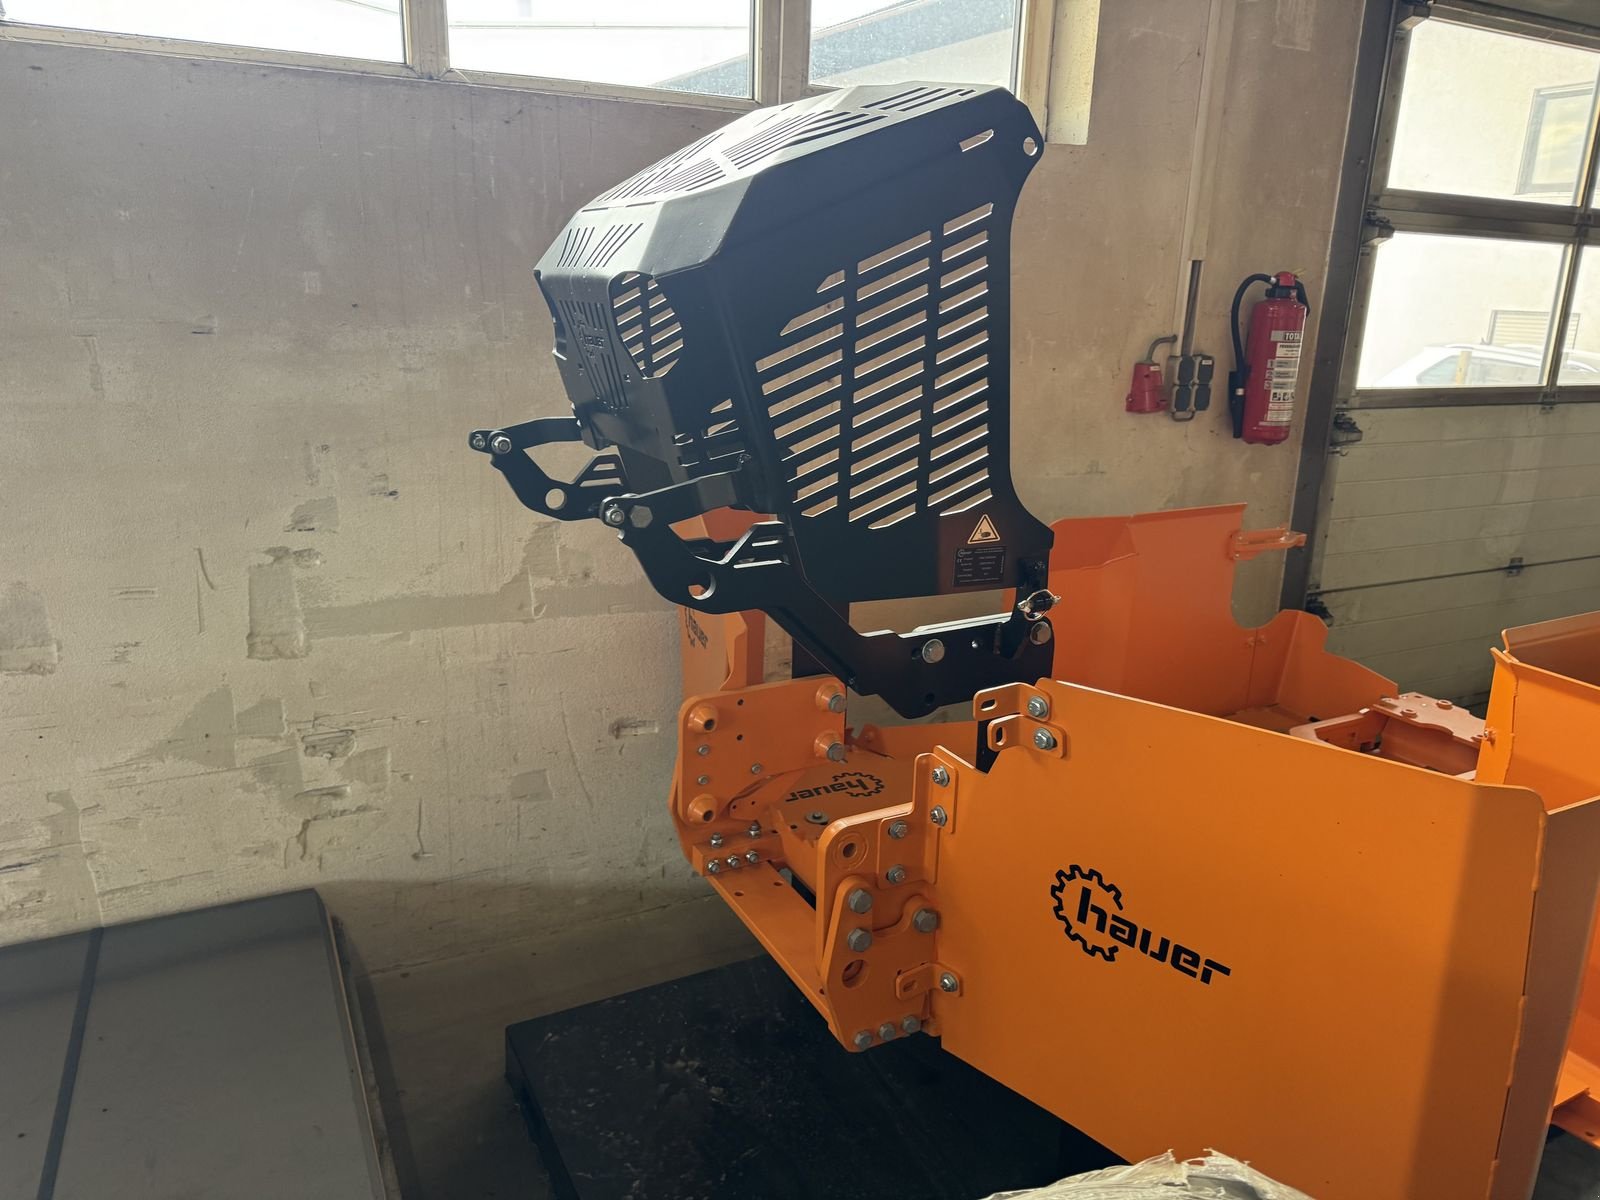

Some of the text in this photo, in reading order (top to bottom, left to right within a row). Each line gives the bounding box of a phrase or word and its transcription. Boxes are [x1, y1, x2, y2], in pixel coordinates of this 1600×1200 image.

[1285, 333, 1301, 341] TOTA
[785, 779, 869, 802] hauer
[1077, 886, 1231, 985] hauer
